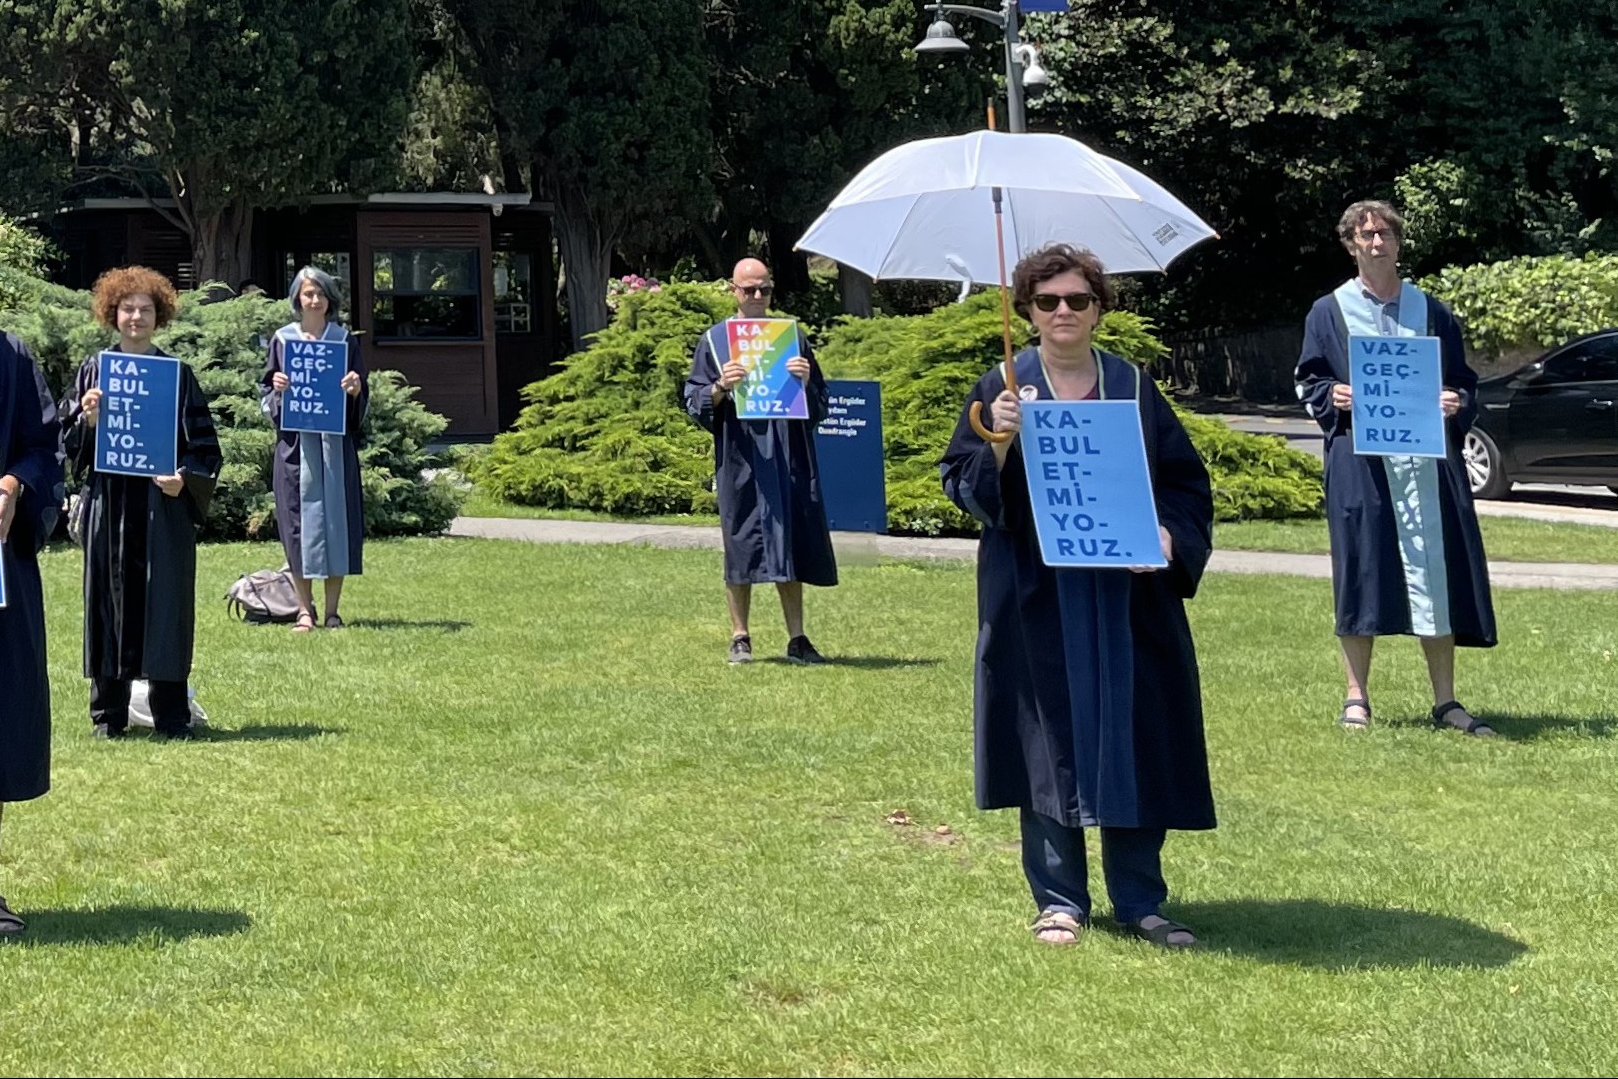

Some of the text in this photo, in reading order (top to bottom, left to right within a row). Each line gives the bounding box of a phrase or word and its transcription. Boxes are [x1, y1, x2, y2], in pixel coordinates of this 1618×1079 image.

[736, 324, 770, 336] KA-
[292, 343, 333, 355] VAZ-
[738, 339, 776, 351] BUL
[1362, 341, 1418, 356] VAZ-
[110, 359, 148, 376] KA-
[291, 357, 333, 373] GEÇ-
[740, 354, 770, 366] ET-
[290, 369, 318, 383] Mİ-
[1362, 363, 1420, 380] GEÇ-
[109, 378, 149, 395] BUL
[290, 386, 320, 398] YO-
[744, 384, 777, 397] YO-
[1363, 380, 1400, 397] Mİ-
[108, 396, 140, 411] ET-
[290, 400, 329, 414] RUZ.
[746, 400, 790, 413] RUZ.
[1364, 404, 1406, 418] YO-
[108, 412, 140, 431] Mİ-
[1034, 410, 1092, 429] KA-
[107, 432, 144, 449] YO-
[1366, 428, 1421, 443] RUZ.
[1038, 435, 1100, 455] BUL
[106, 451, 155, 470] RUZ.
[1042, 461, 1092, 481] ET-
[1046, 483, 1097, 507] Mİ-
[1050, 513, 1108, 532] YO-
[1056, 538, 1132, 557] RUZ.
